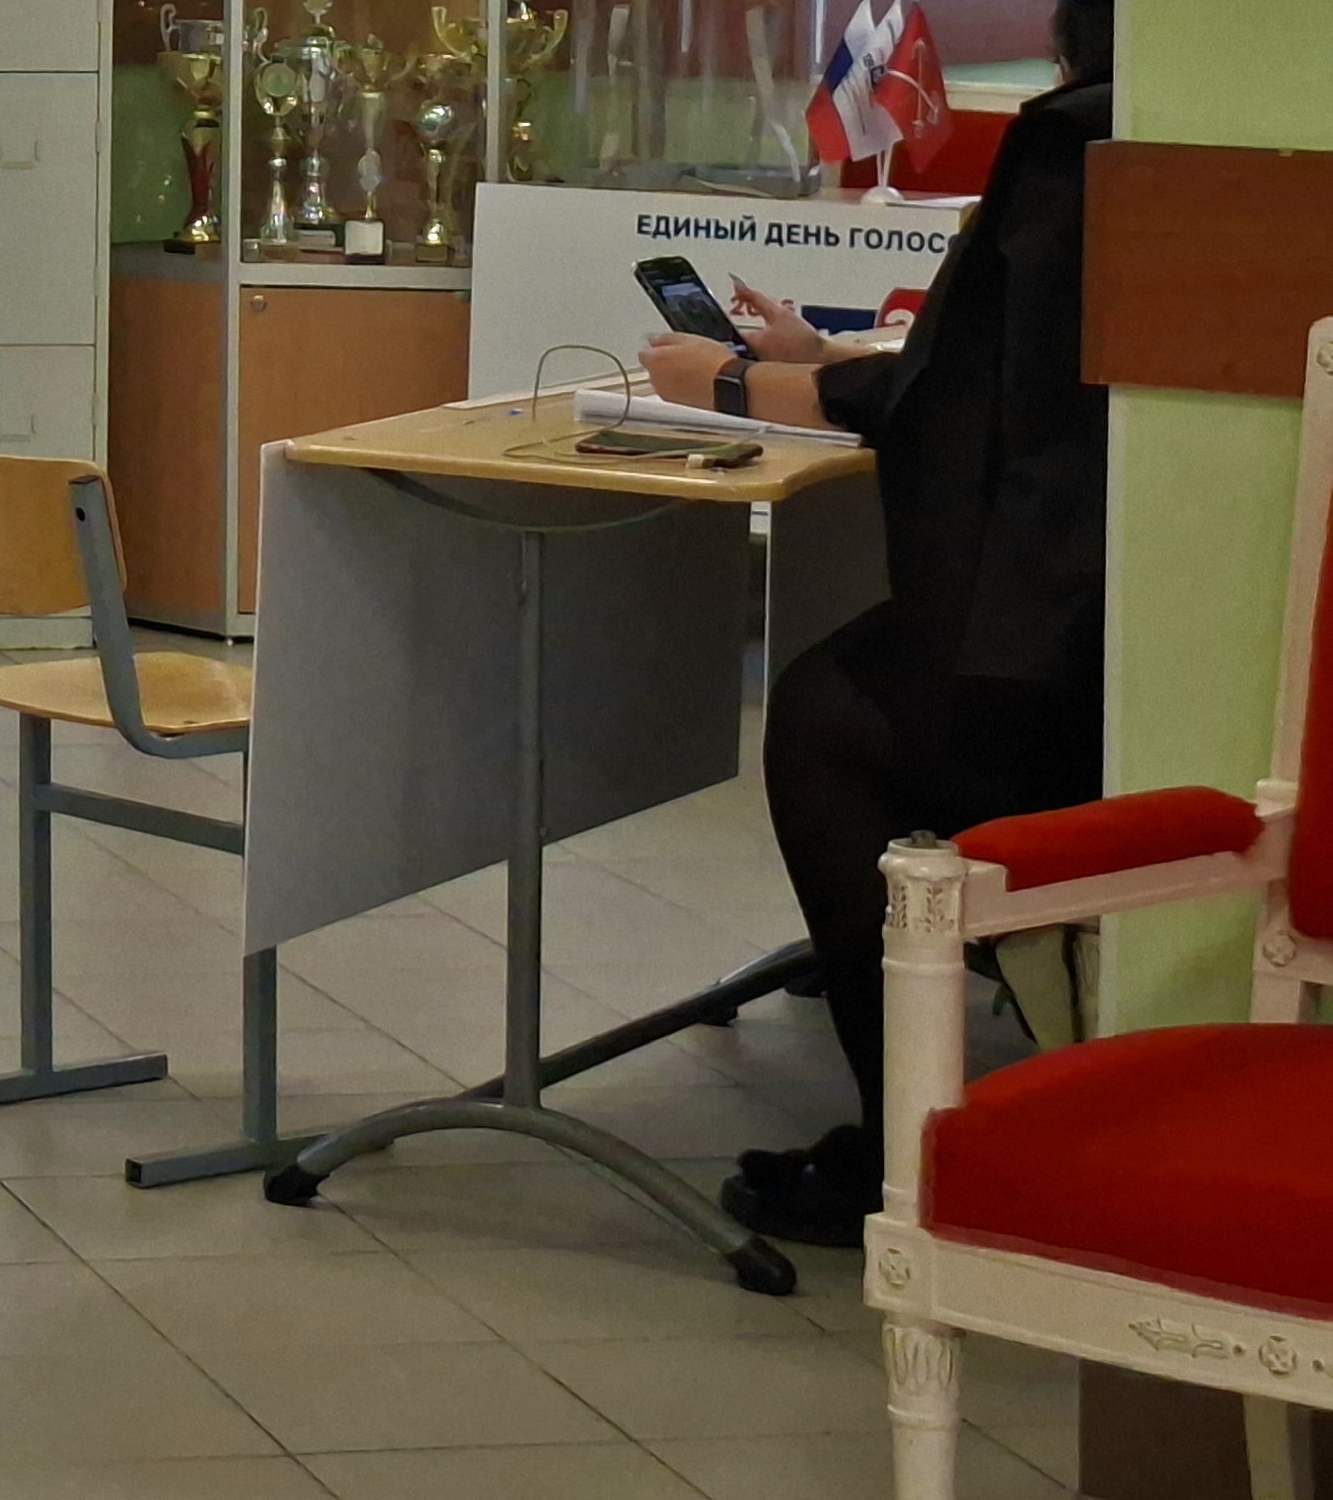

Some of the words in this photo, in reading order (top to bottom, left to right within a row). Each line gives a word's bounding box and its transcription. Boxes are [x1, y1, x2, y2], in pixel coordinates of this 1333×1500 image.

[637, 214, 757, 243] ЕДИНЫЙ
[765, 221, 840, 248] ДЕНЬ
[849, 227, 957, 253] ГОЛОС
